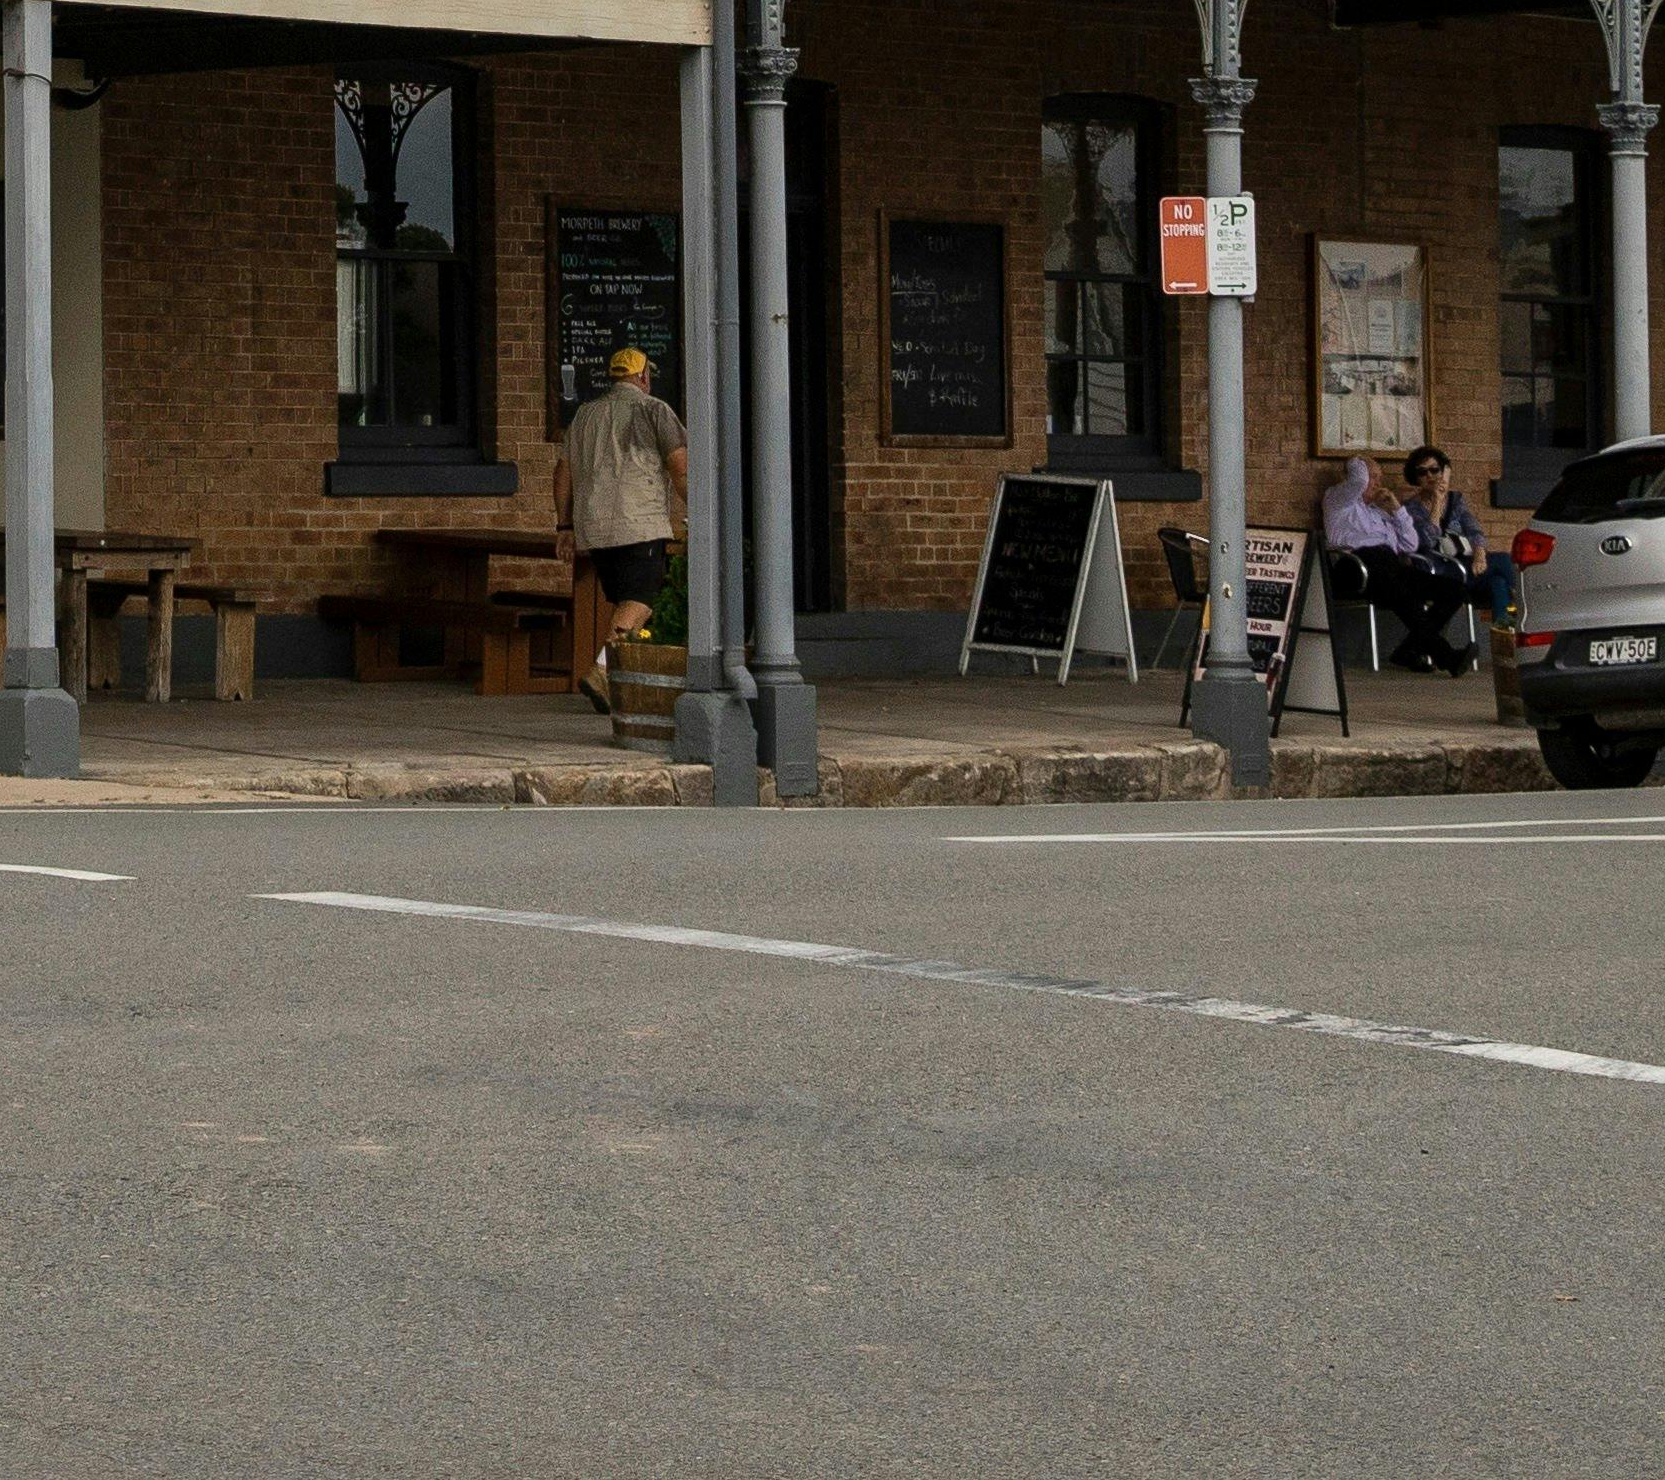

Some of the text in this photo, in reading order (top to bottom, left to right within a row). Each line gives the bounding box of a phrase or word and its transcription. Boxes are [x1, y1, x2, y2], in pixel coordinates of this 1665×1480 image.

[1174, 204, 1194, 220] NO
[1162, 223, 1206, 238] STOPPING
[1245, 540, 1295, 554] RTISAN
[1603, 539, 1627, 552] KIA
[1245, 552, 1284, 566] REWERY
[1245, 595, 1283, 615] EERS
[1249, 621, 1273, 632] HOUR
